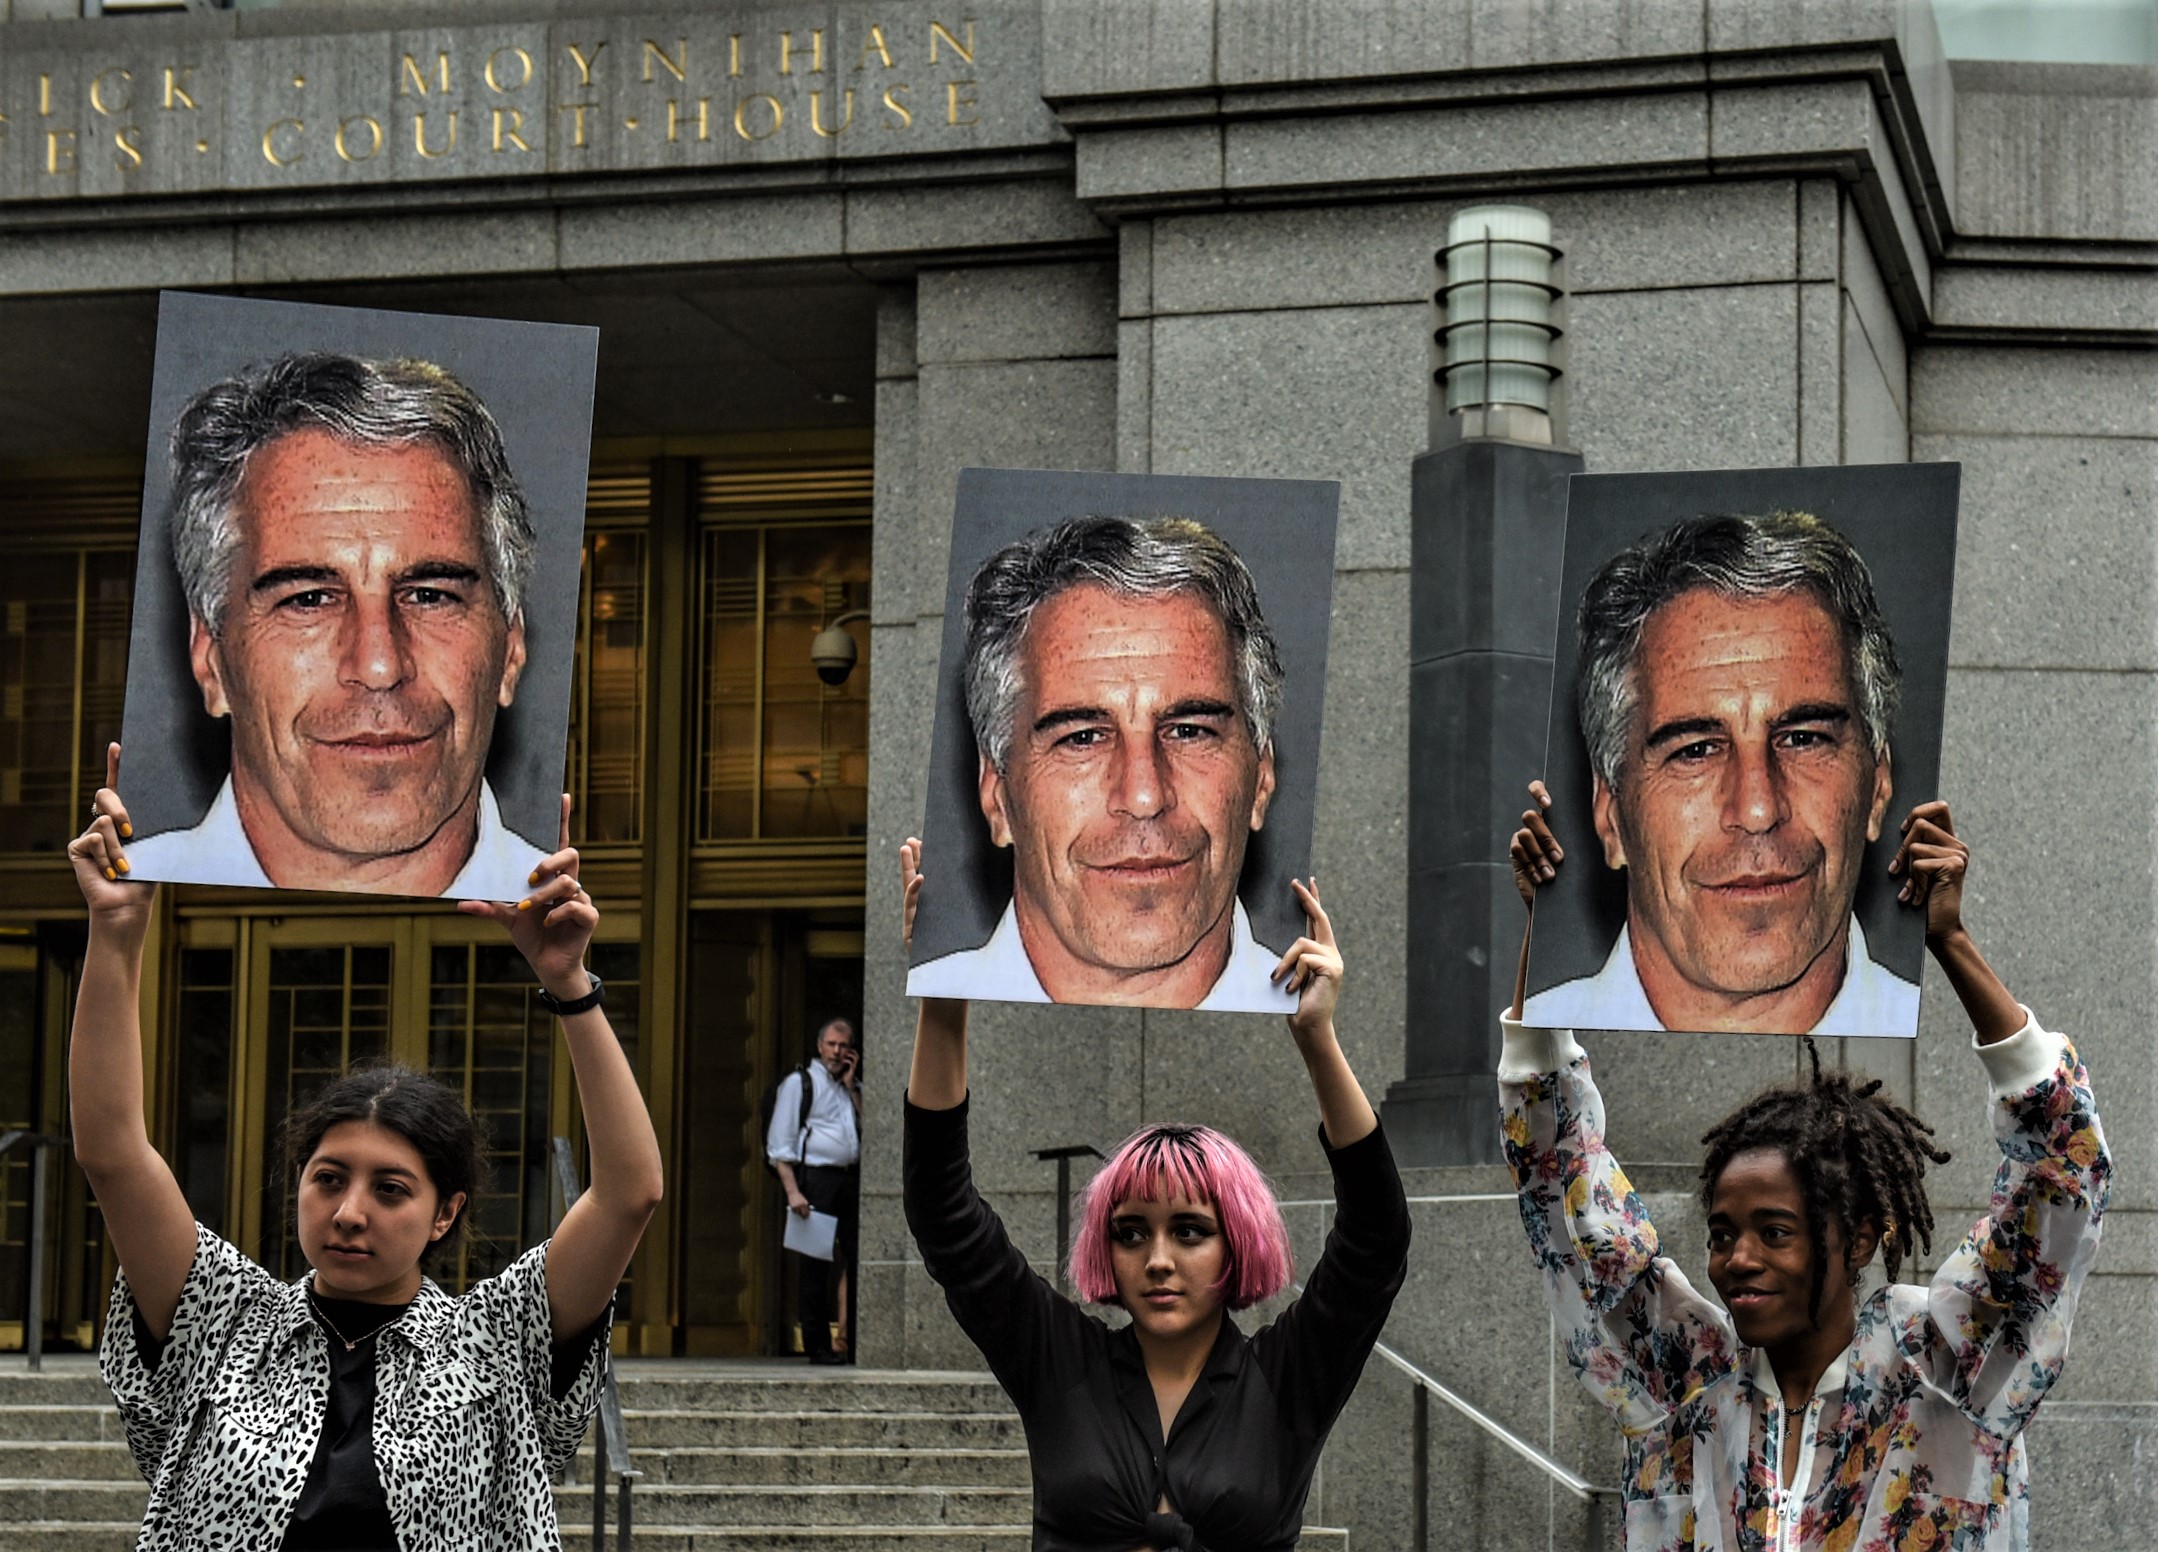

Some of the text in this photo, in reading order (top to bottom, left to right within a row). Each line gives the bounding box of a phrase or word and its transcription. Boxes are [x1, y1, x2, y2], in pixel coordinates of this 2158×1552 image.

[0, 17, 979, 124] ICK MOYNIHAN
[0, 126, 143, 176] ES
